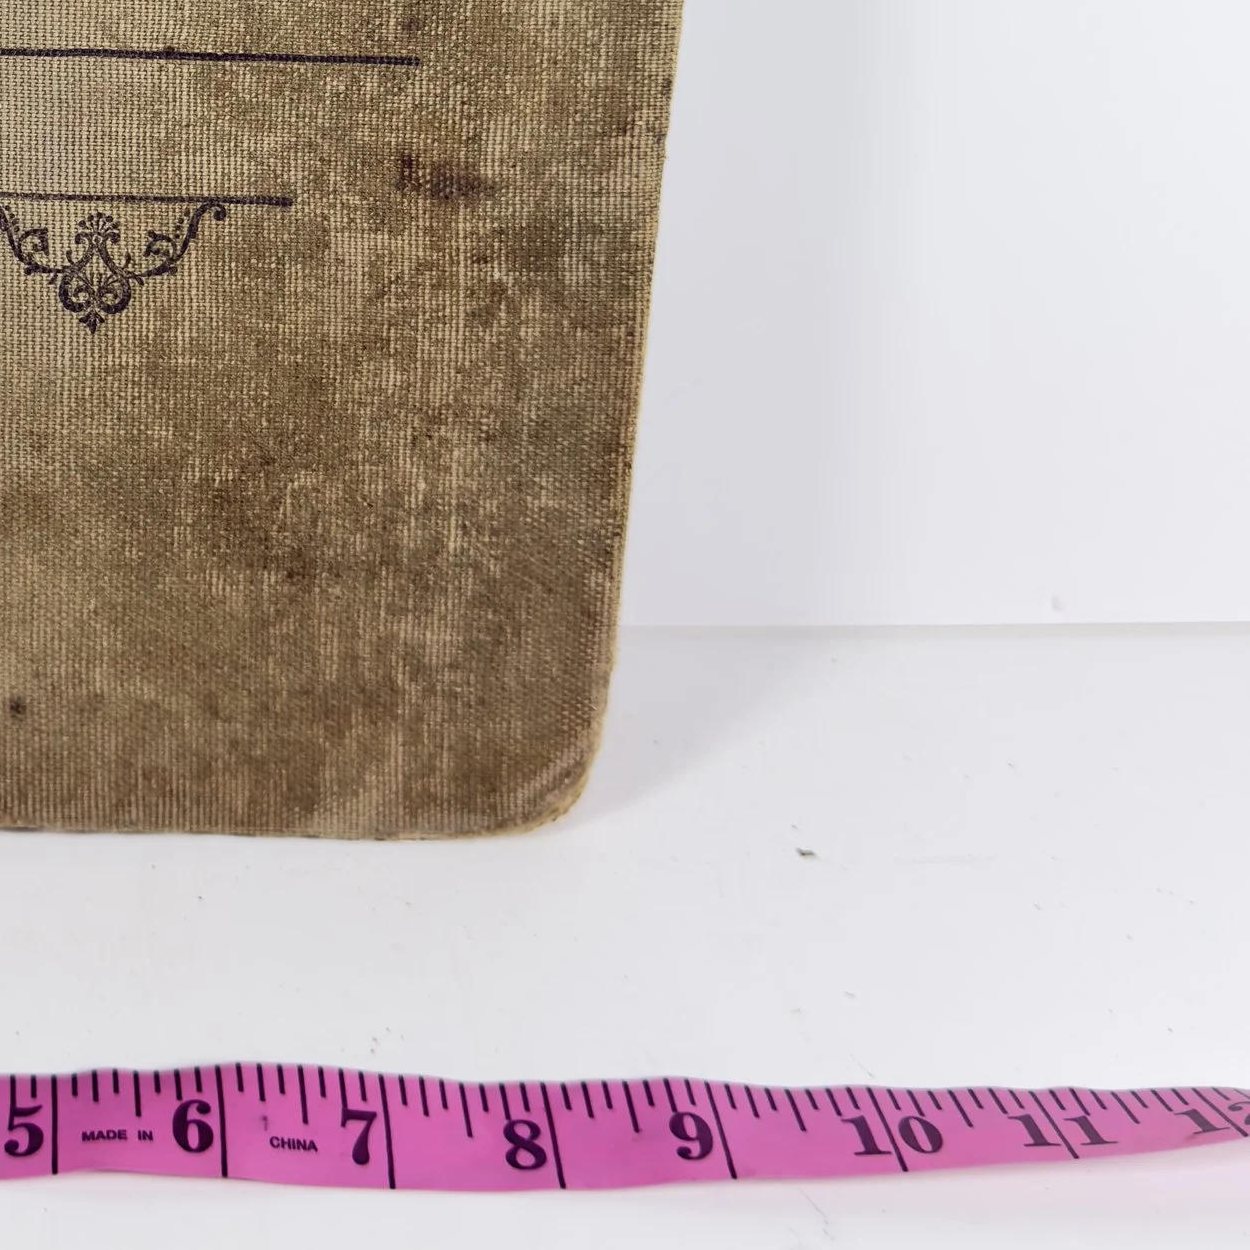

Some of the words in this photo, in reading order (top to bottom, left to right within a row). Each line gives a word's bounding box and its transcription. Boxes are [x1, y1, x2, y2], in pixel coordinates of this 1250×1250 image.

[3, 1105, 45, 1157] 5
[81, 1130, 128, 1142] MADE
[137, 1130, 154, 1141] IN
[269, 1136, 318, 1152] CHINA
[171, 1099, 214, 1153] 6
[341, 1110, 377, 1165] 7
[503, 1119, 547, 1170] 8
[668, 1111, 714, 1160] 9
[842, 1115, 944, 1156] 10
[1007, 1111, 1119, 1148] 11
